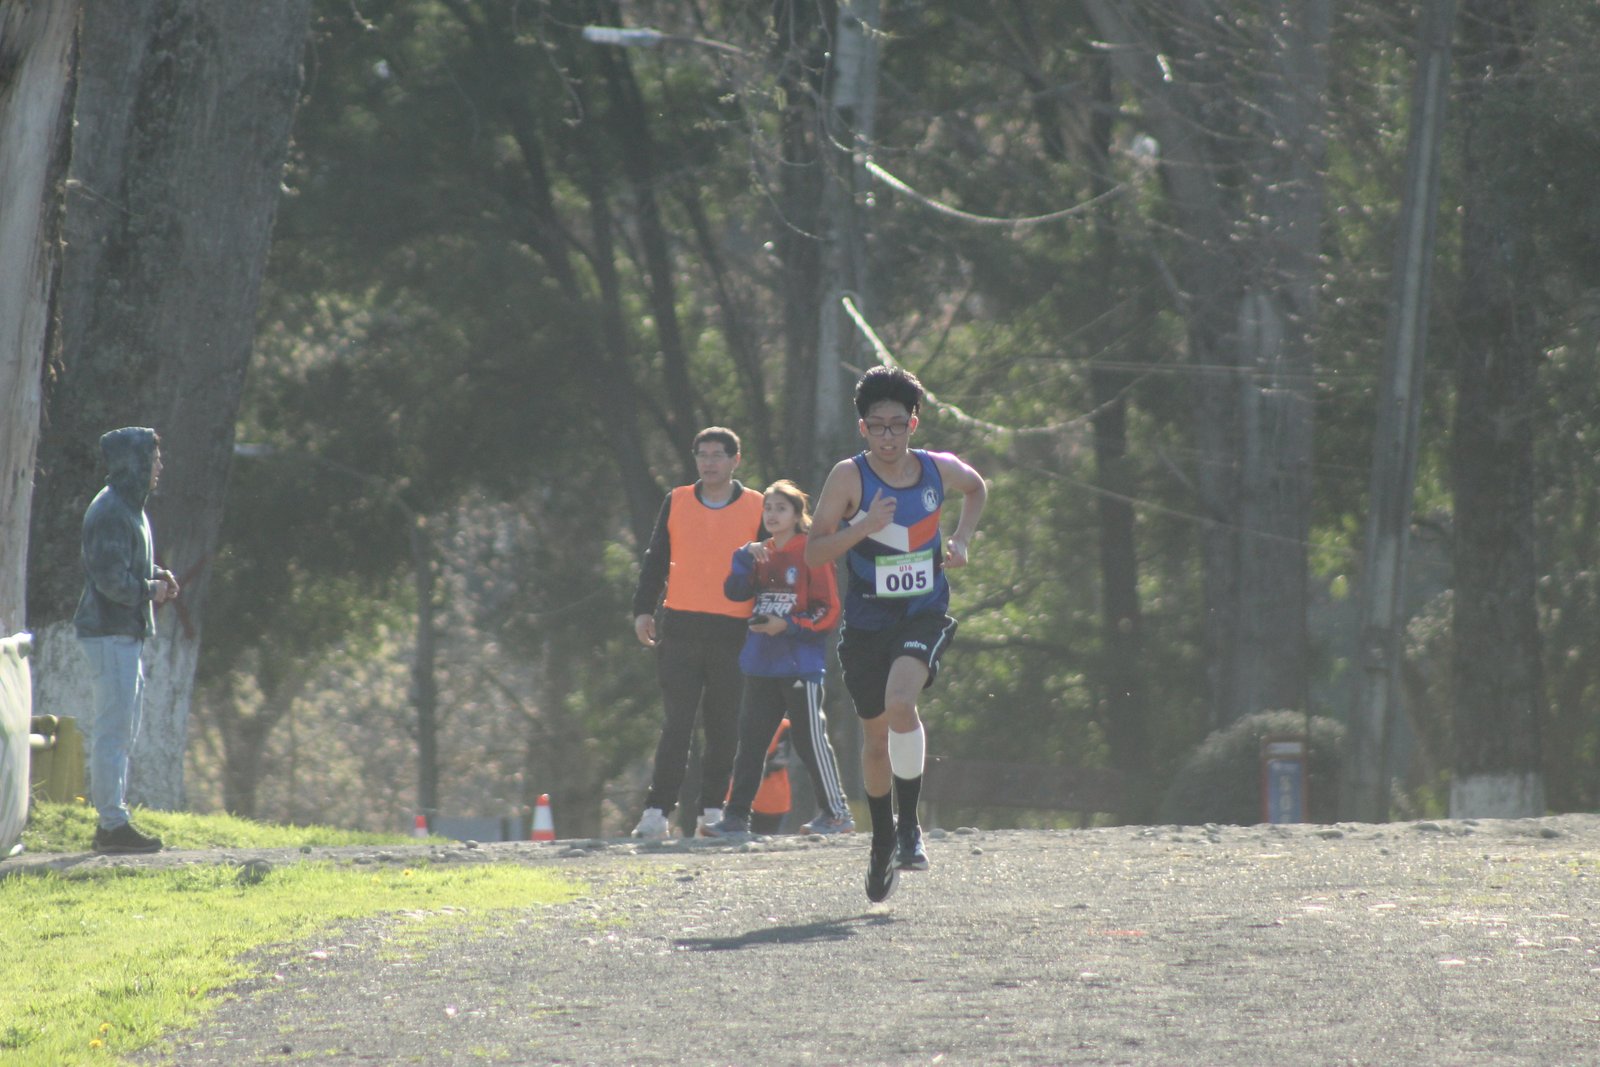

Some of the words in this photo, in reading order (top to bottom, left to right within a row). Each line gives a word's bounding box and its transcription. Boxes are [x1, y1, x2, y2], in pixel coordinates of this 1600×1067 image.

[899, 564, 913, 572] U16
[886, 570, 927, 592] 005
[903, 640, 928, 650] mitre
